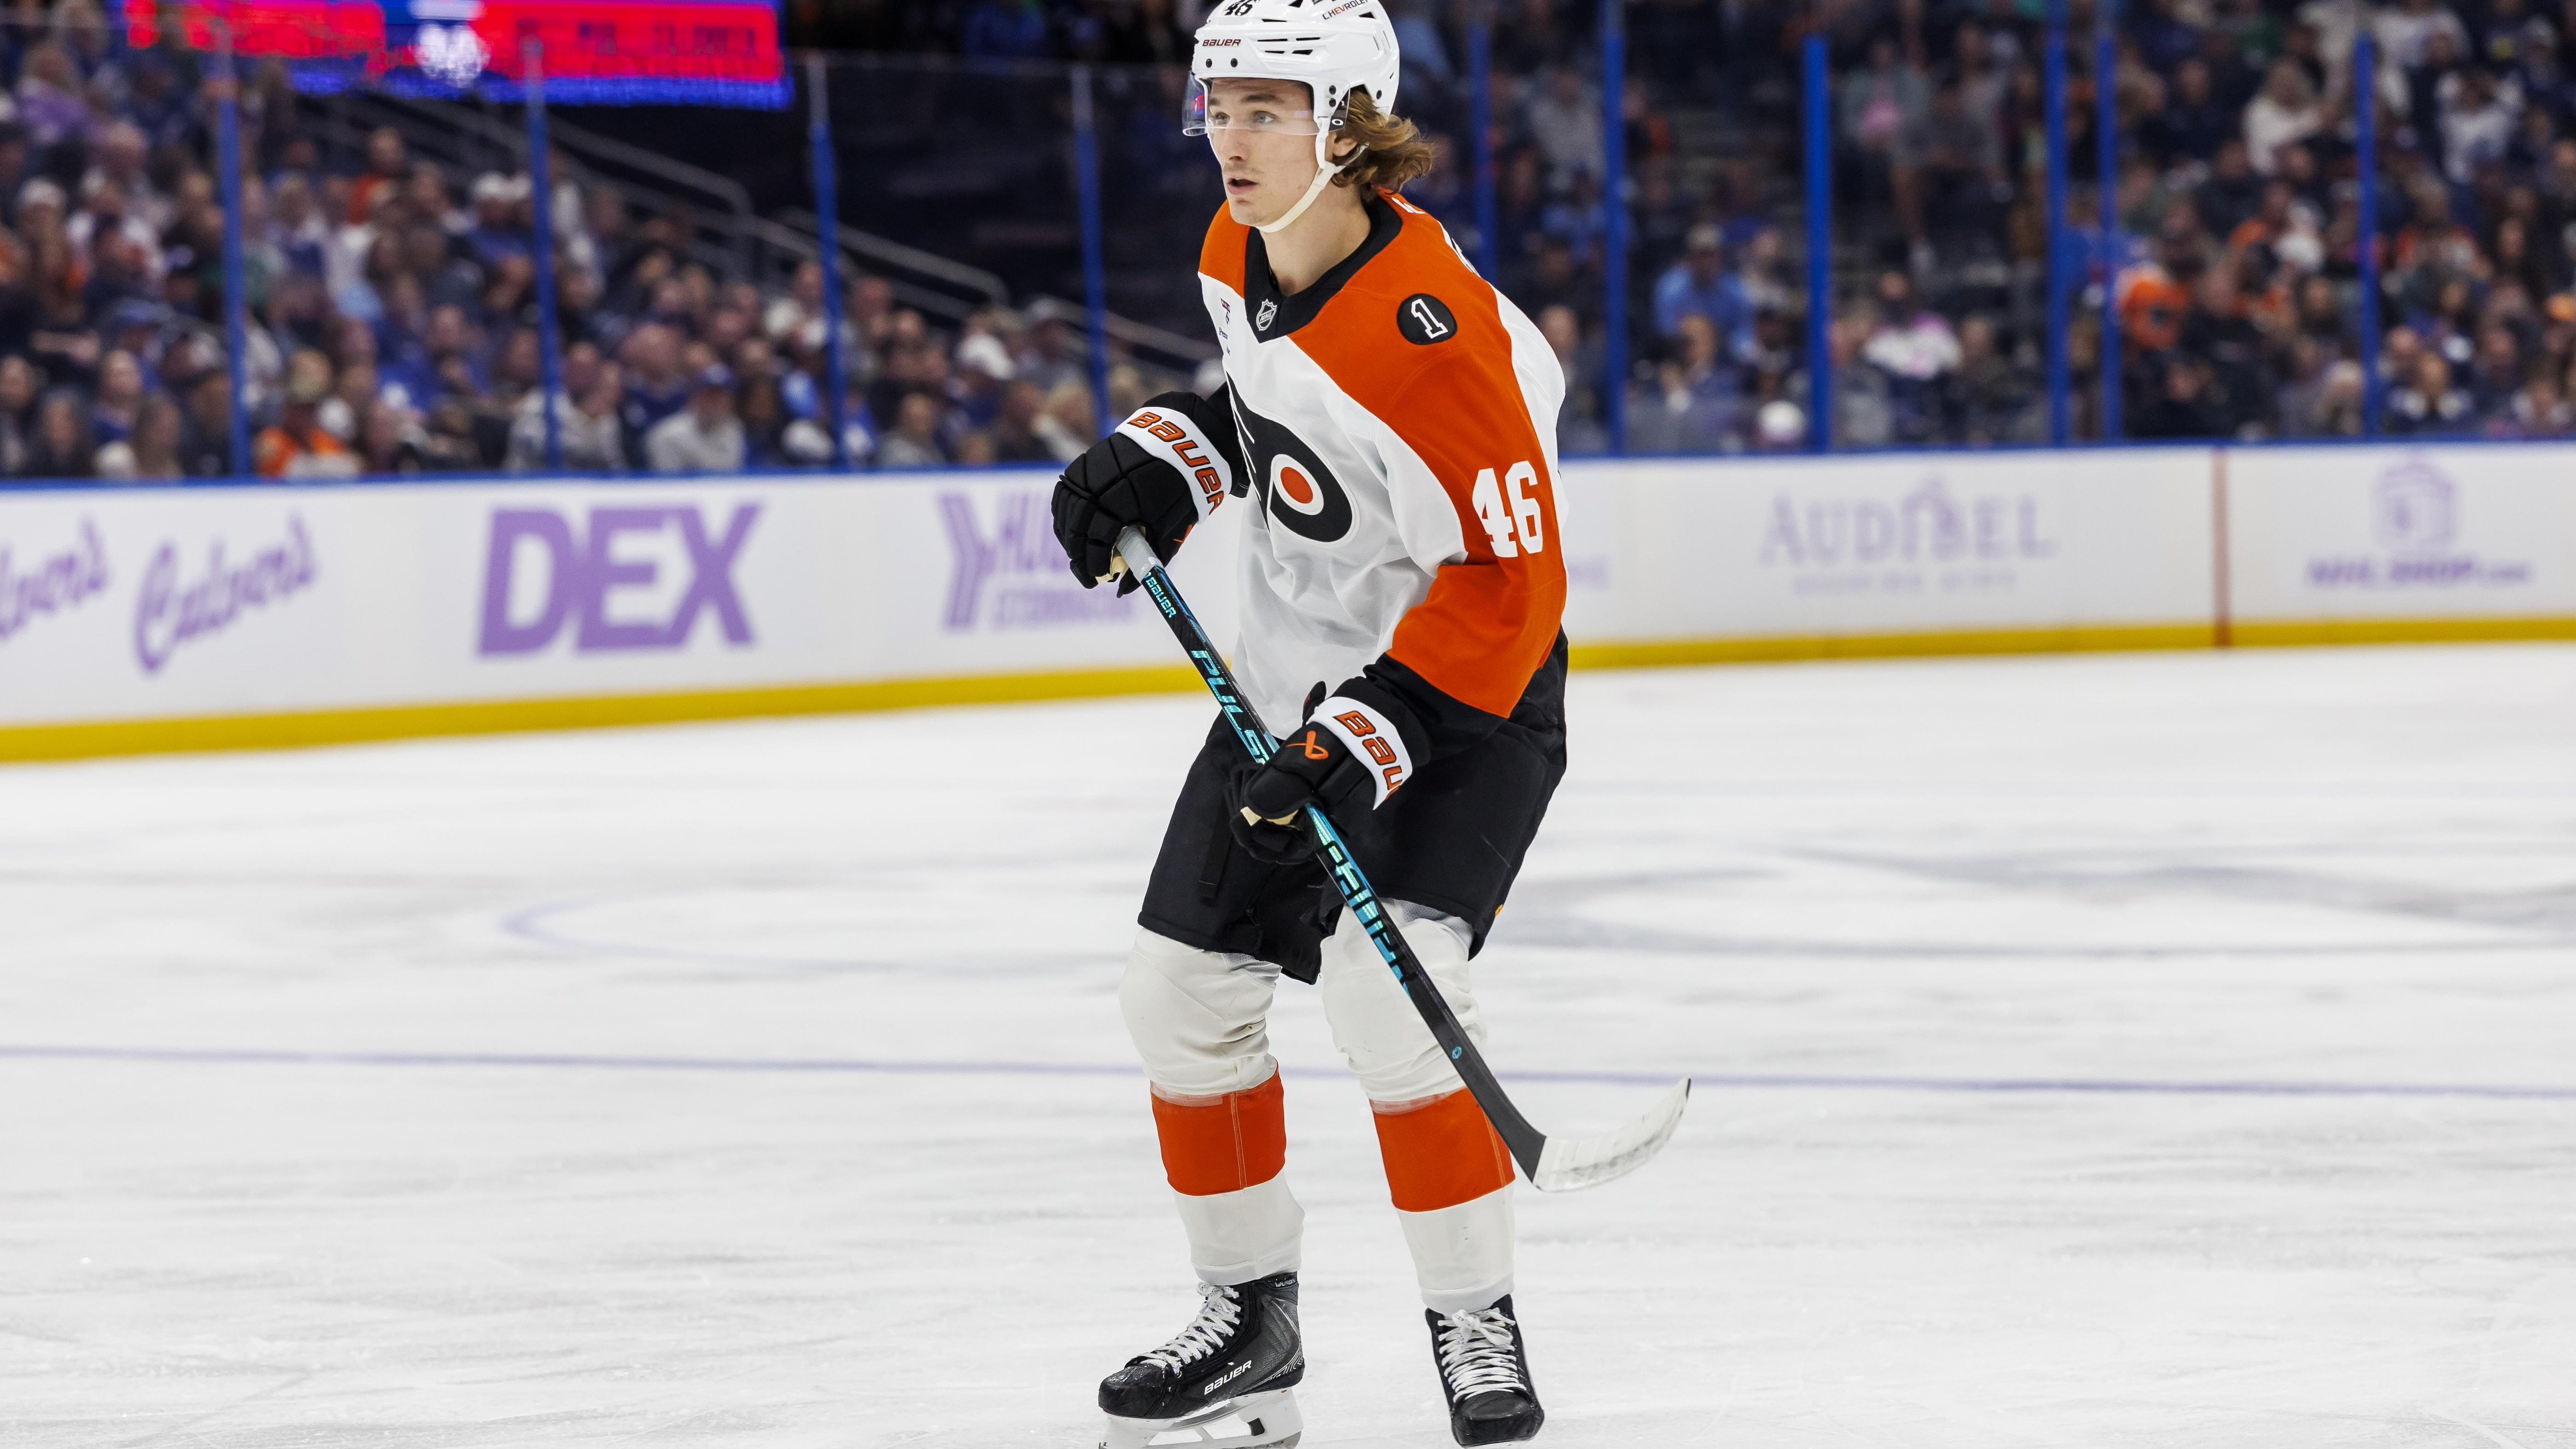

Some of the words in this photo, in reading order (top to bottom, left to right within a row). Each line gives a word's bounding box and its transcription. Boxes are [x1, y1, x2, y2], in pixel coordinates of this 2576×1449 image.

[1126, 412, 1224, 515] BAUER
[1472, 460, 1543, 558] 46
[477, 502, 764, 657] DEX
[1146, 577, 1176, 618] BAUER
[1332, 710, 1402, 800] BAU
[1204, 1360, 1251, 1395] BAUER
